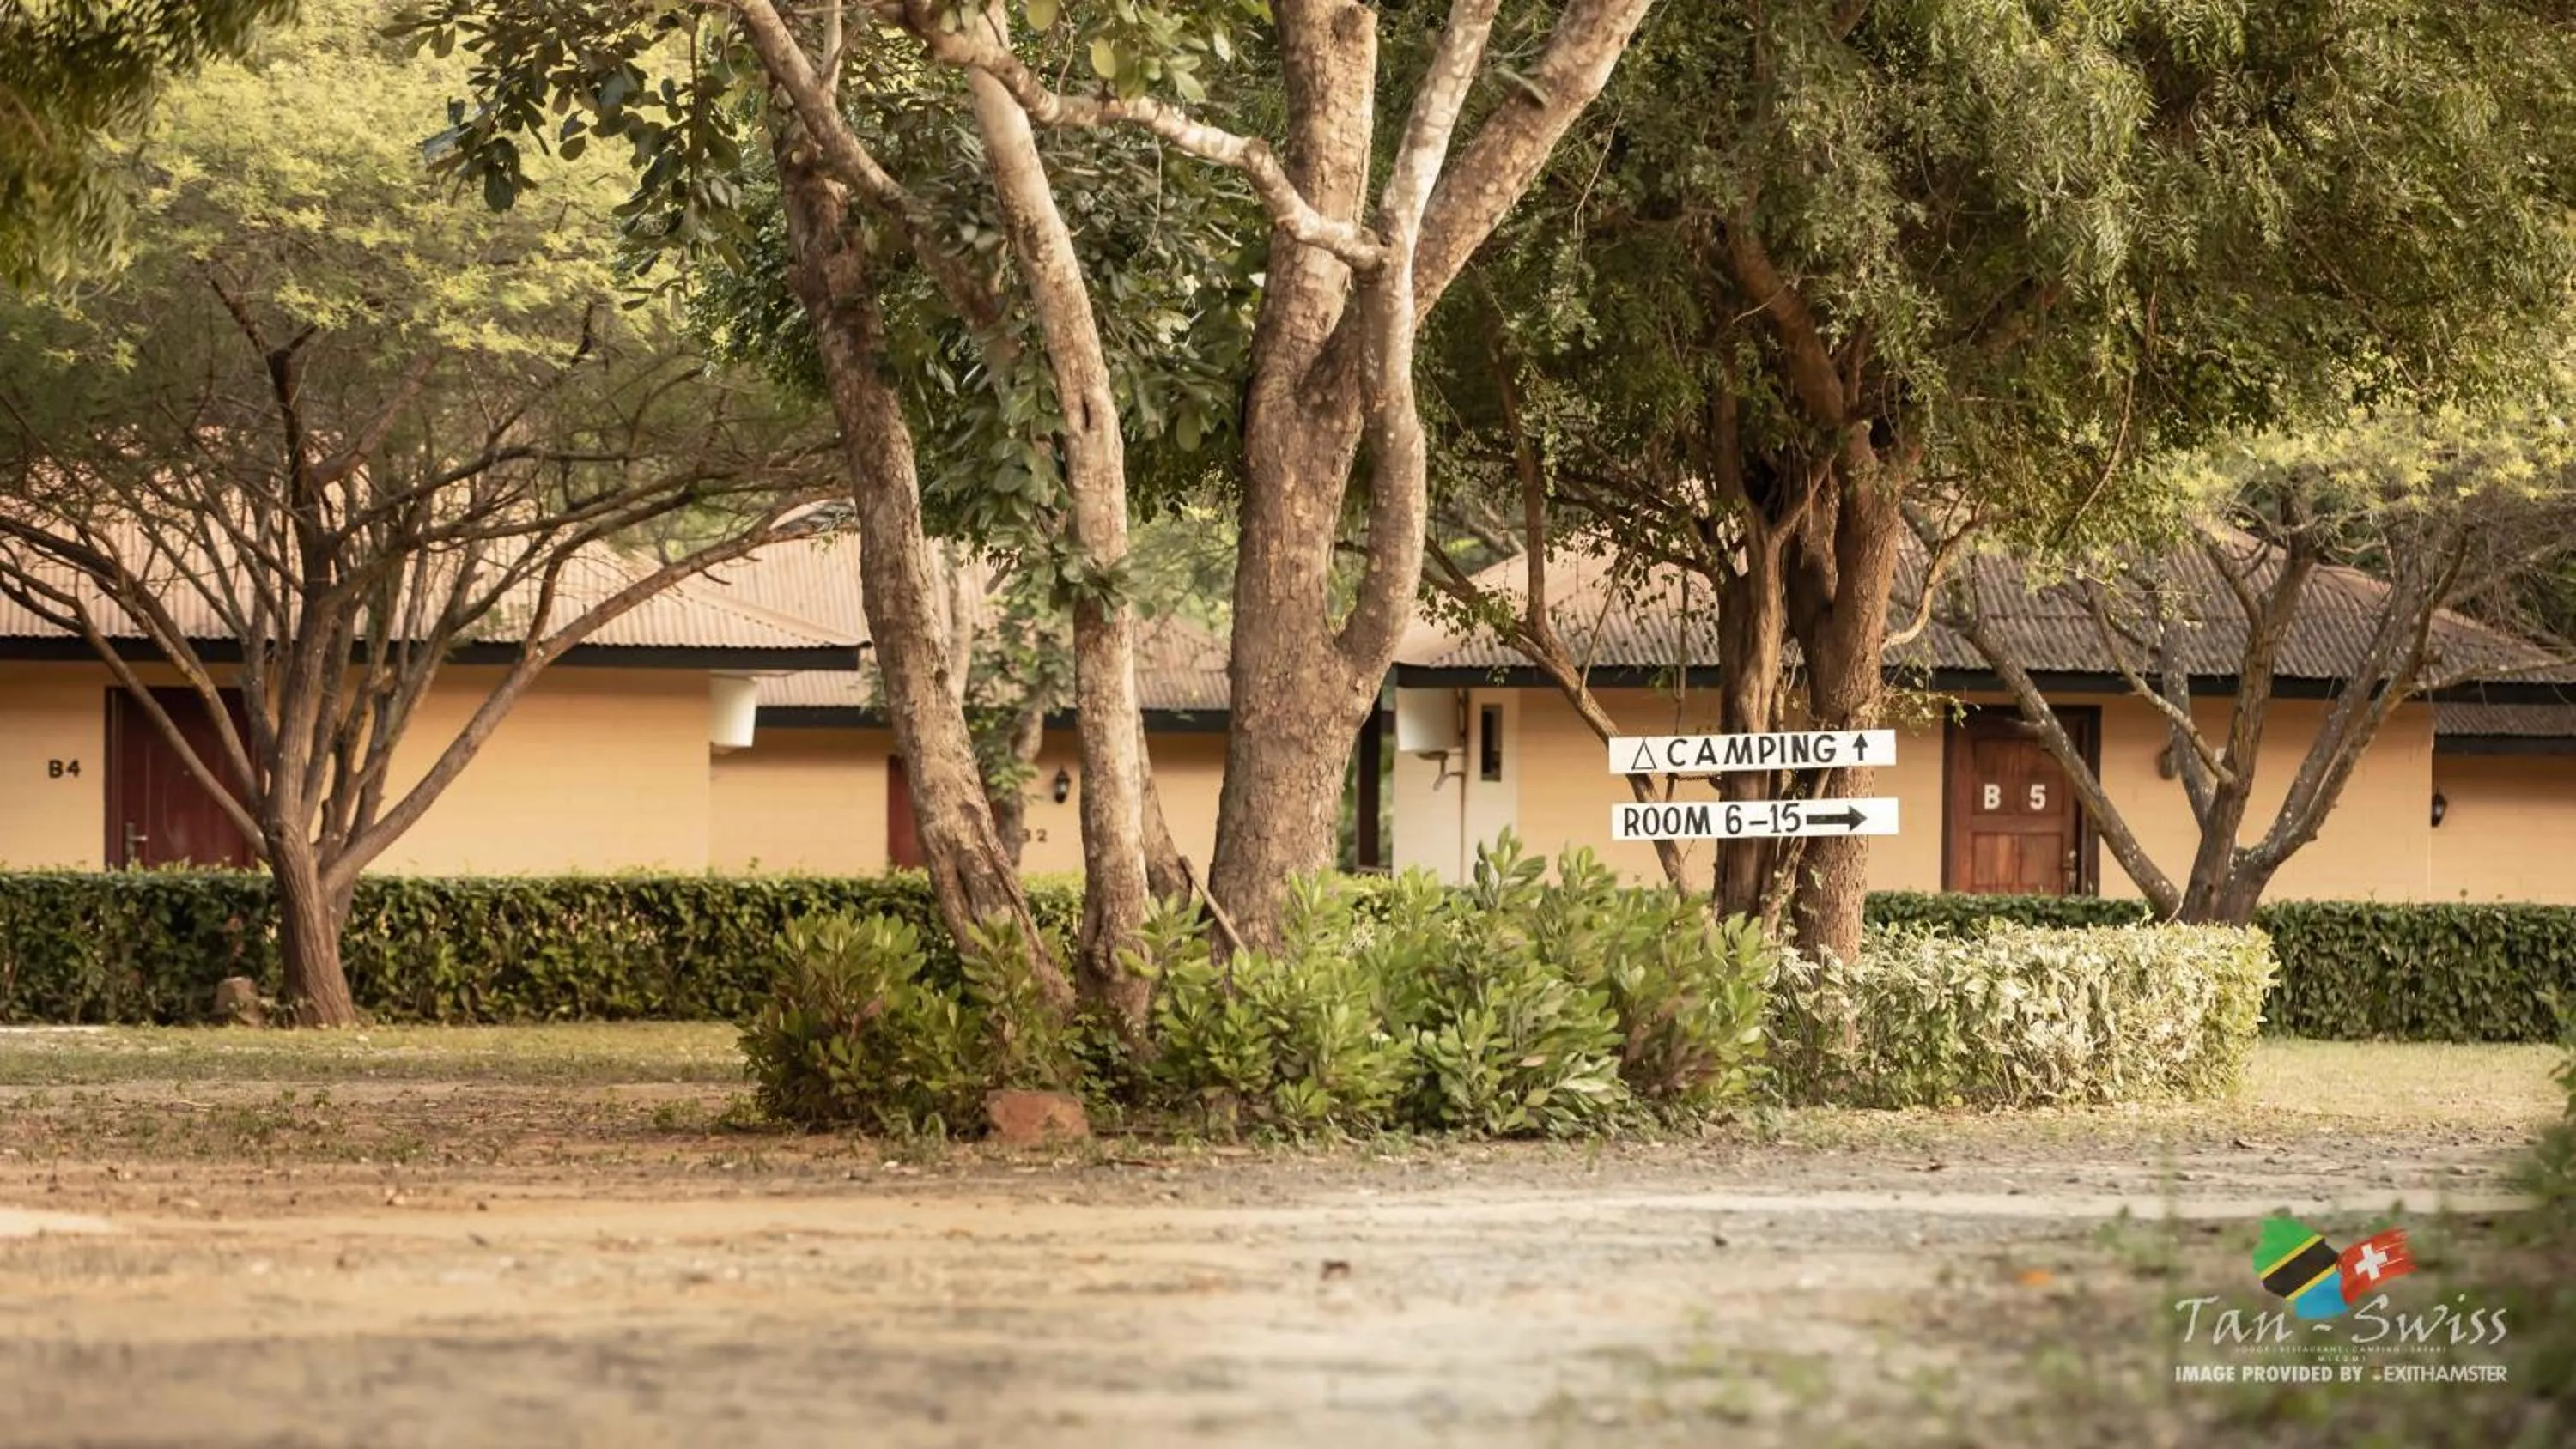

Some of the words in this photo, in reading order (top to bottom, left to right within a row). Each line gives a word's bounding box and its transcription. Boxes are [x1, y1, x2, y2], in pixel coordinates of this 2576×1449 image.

[1666, 733, 1838, 767] CAMPING
[48, 759, 81, 779] B4
[1624, 805, 1712, 837] ROOM
[1725, 803, 1801, 835] 6-15
